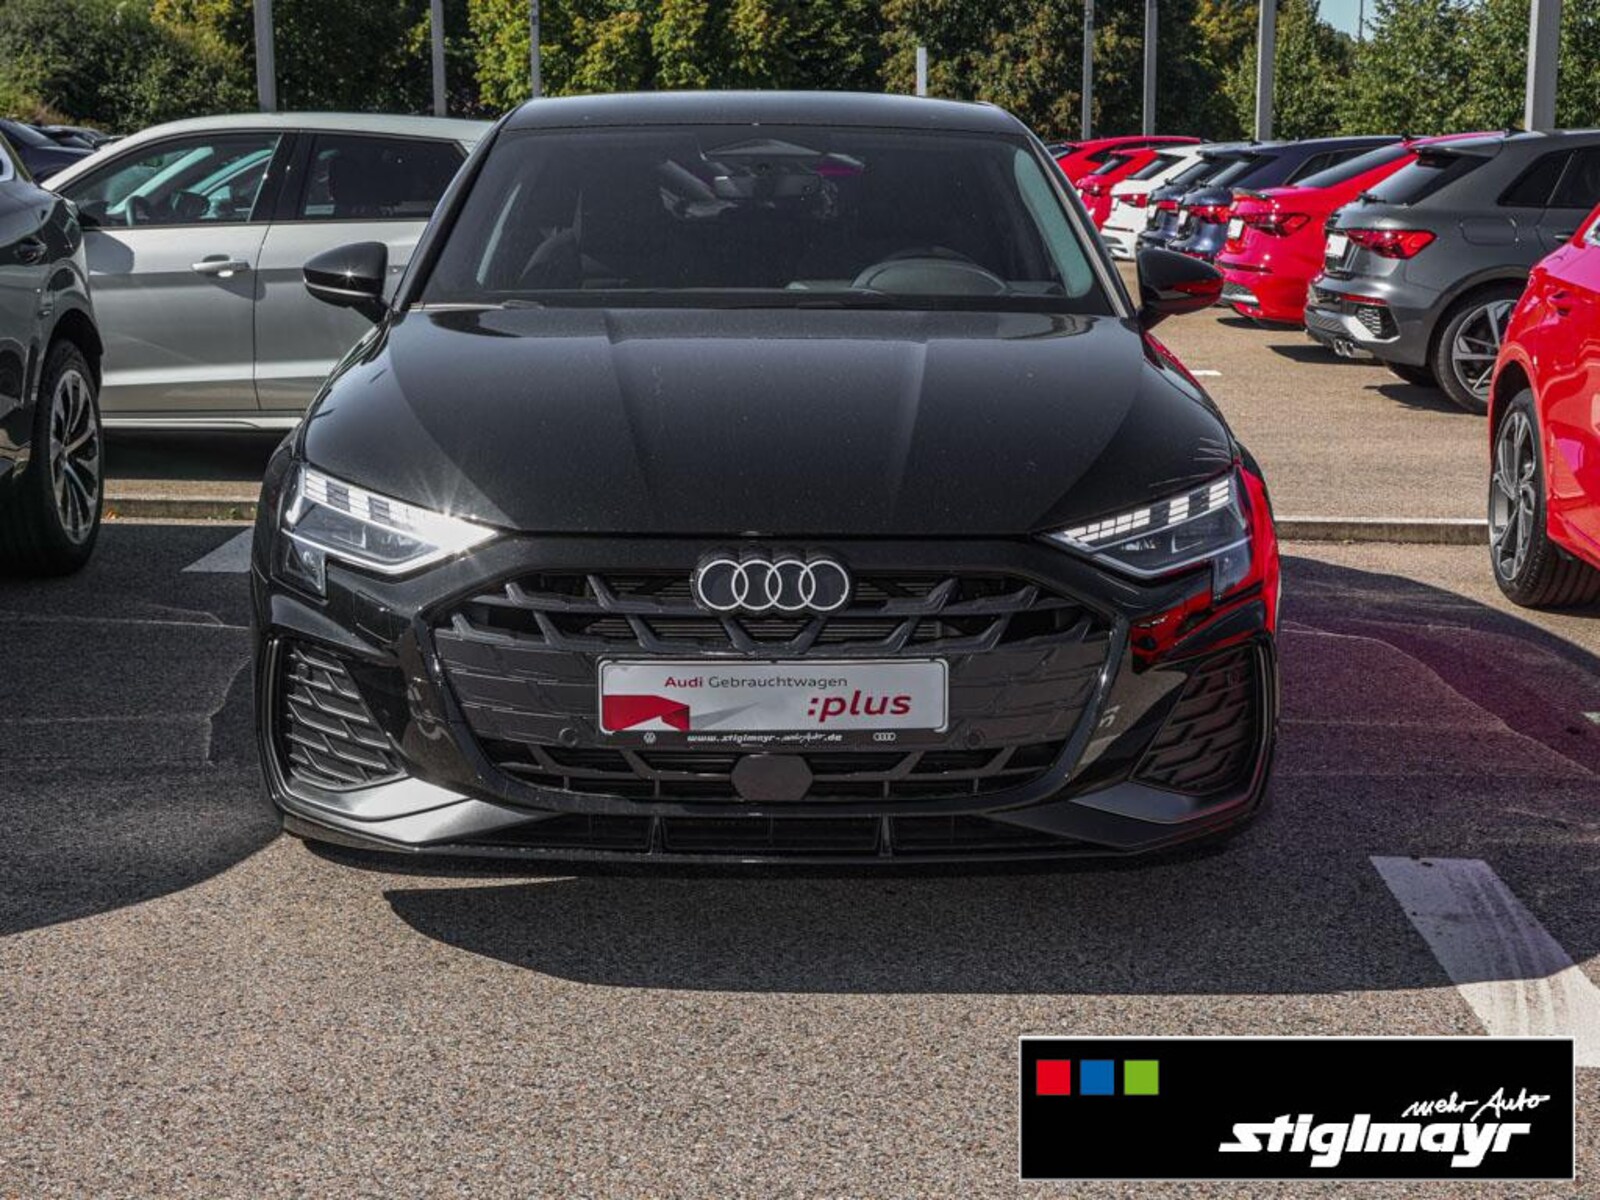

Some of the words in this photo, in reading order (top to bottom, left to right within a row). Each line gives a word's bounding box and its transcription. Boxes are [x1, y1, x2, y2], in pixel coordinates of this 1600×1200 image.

[664, 676, 703, 688] Audi
[708, 676, 848, 690] Gebrauchtwagen
[807, 690, 912, 723] :plus
